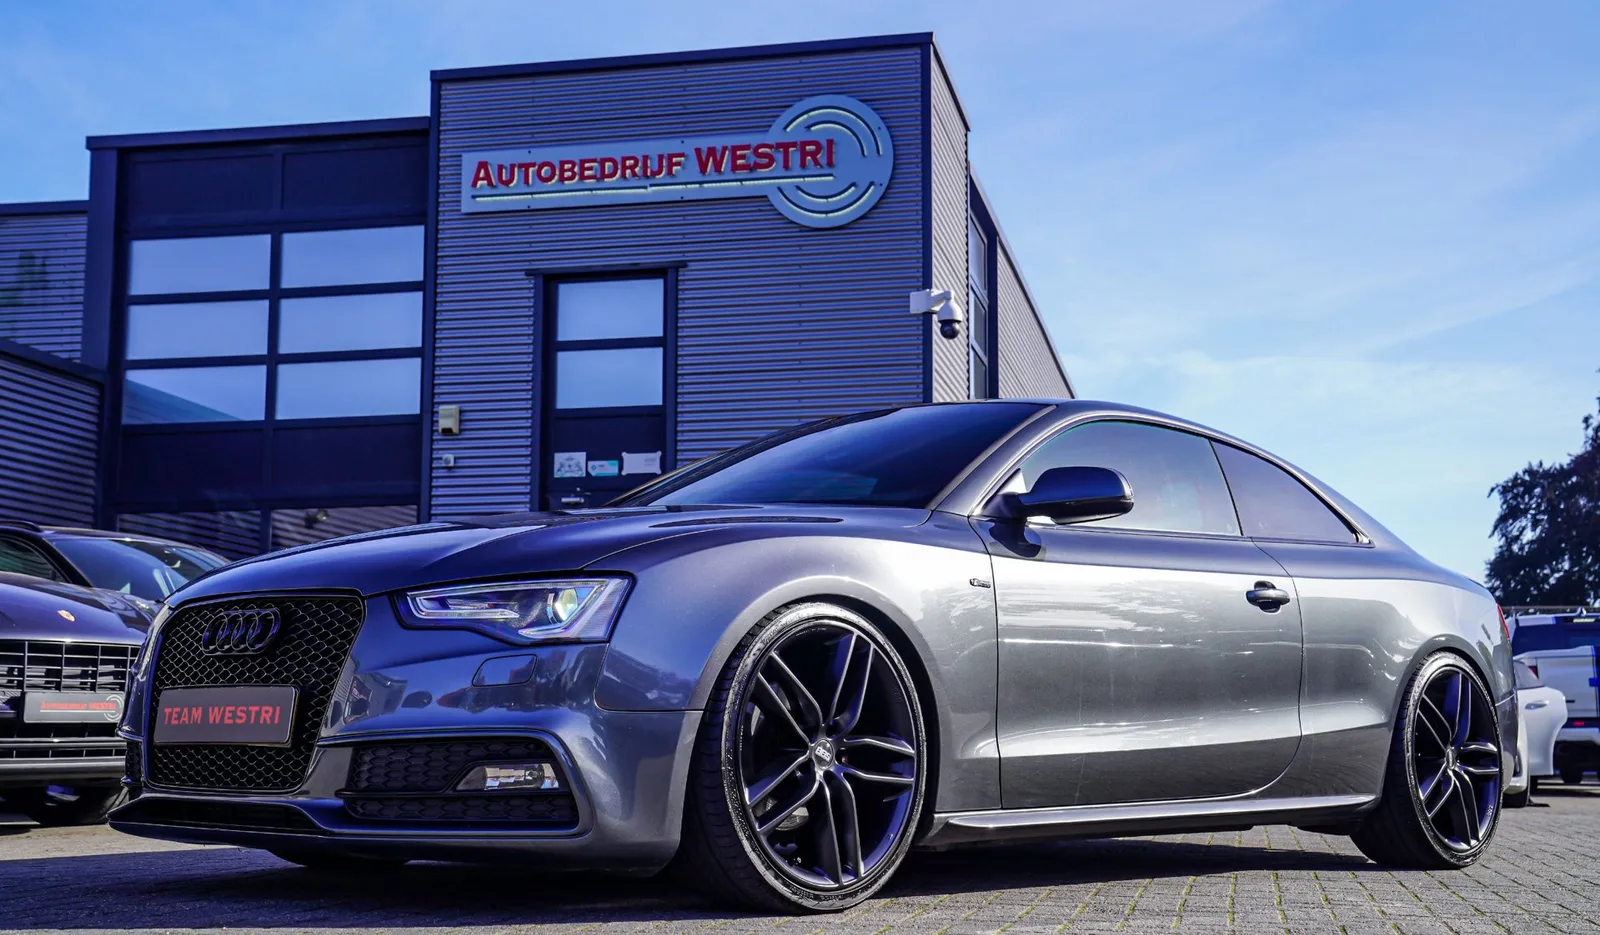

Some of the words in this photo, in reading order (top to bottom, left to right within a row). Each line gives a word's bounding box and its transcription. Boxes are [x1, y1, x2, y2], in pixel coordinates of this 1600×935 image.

[471, 152, 685, 189] AUTOBEDRIJF
[694, 138, 836, 175] WESTRI
[163, 706, 203, 725] TEAM
[208, 705, 281, 725] WESTRI
